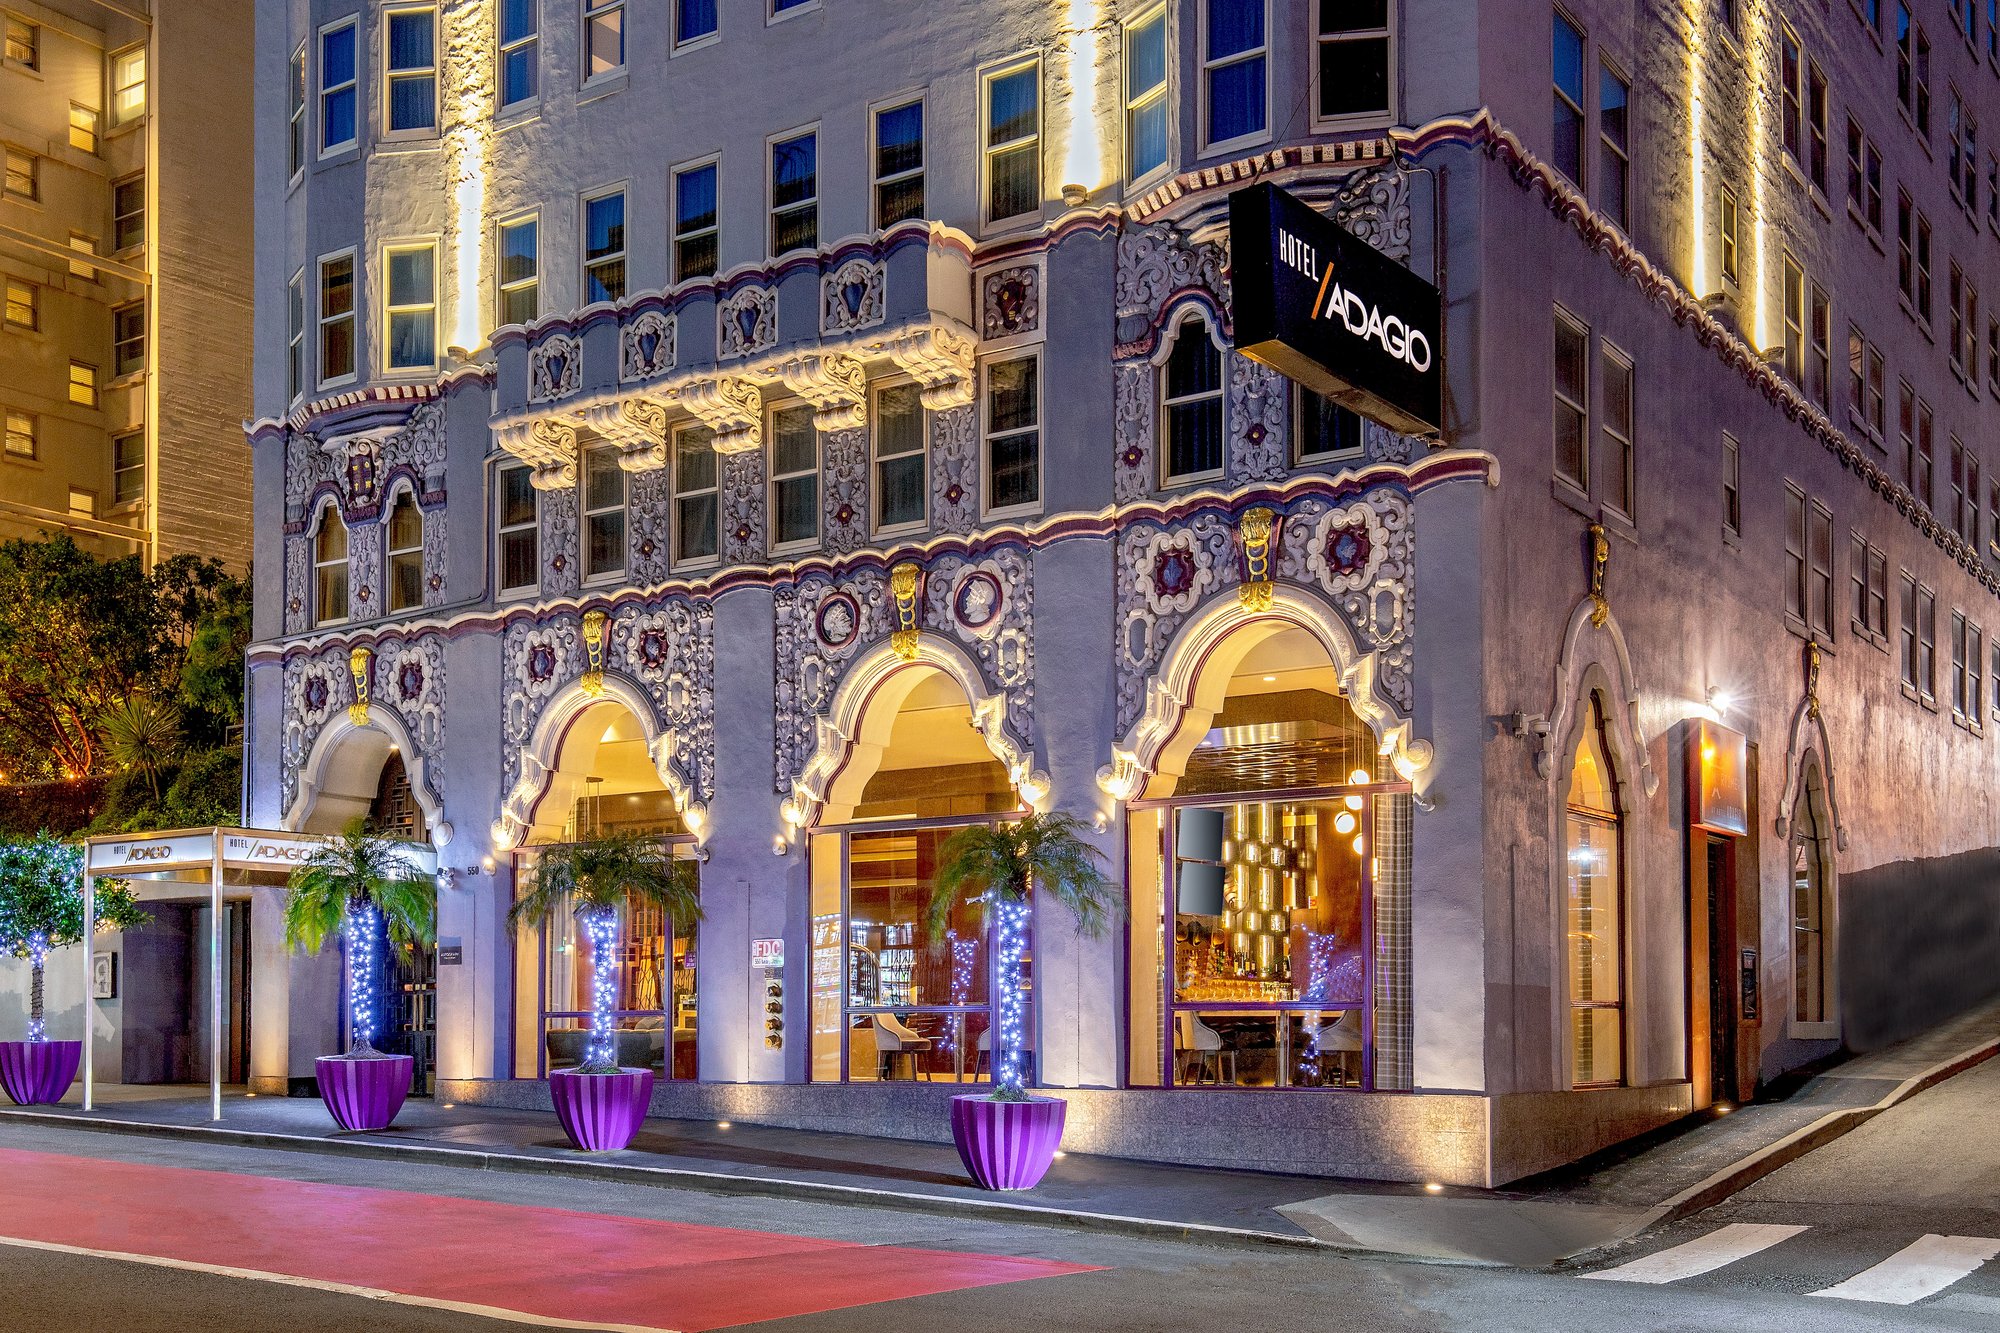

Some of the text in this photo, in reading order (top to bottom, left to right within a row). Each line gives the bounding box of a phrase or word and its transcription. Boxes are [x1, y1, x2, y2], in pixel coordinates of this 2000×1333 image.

[1279, 227, 1431, 373] HOTEL ADAGIO
[113, 845, 172, 862] HOTEL ADAGIO
[229, 838, 313, 861] HOTEL ADAGIO
[467, 865, 480, 876] 550
[756, 940, 781, 957] FDC
